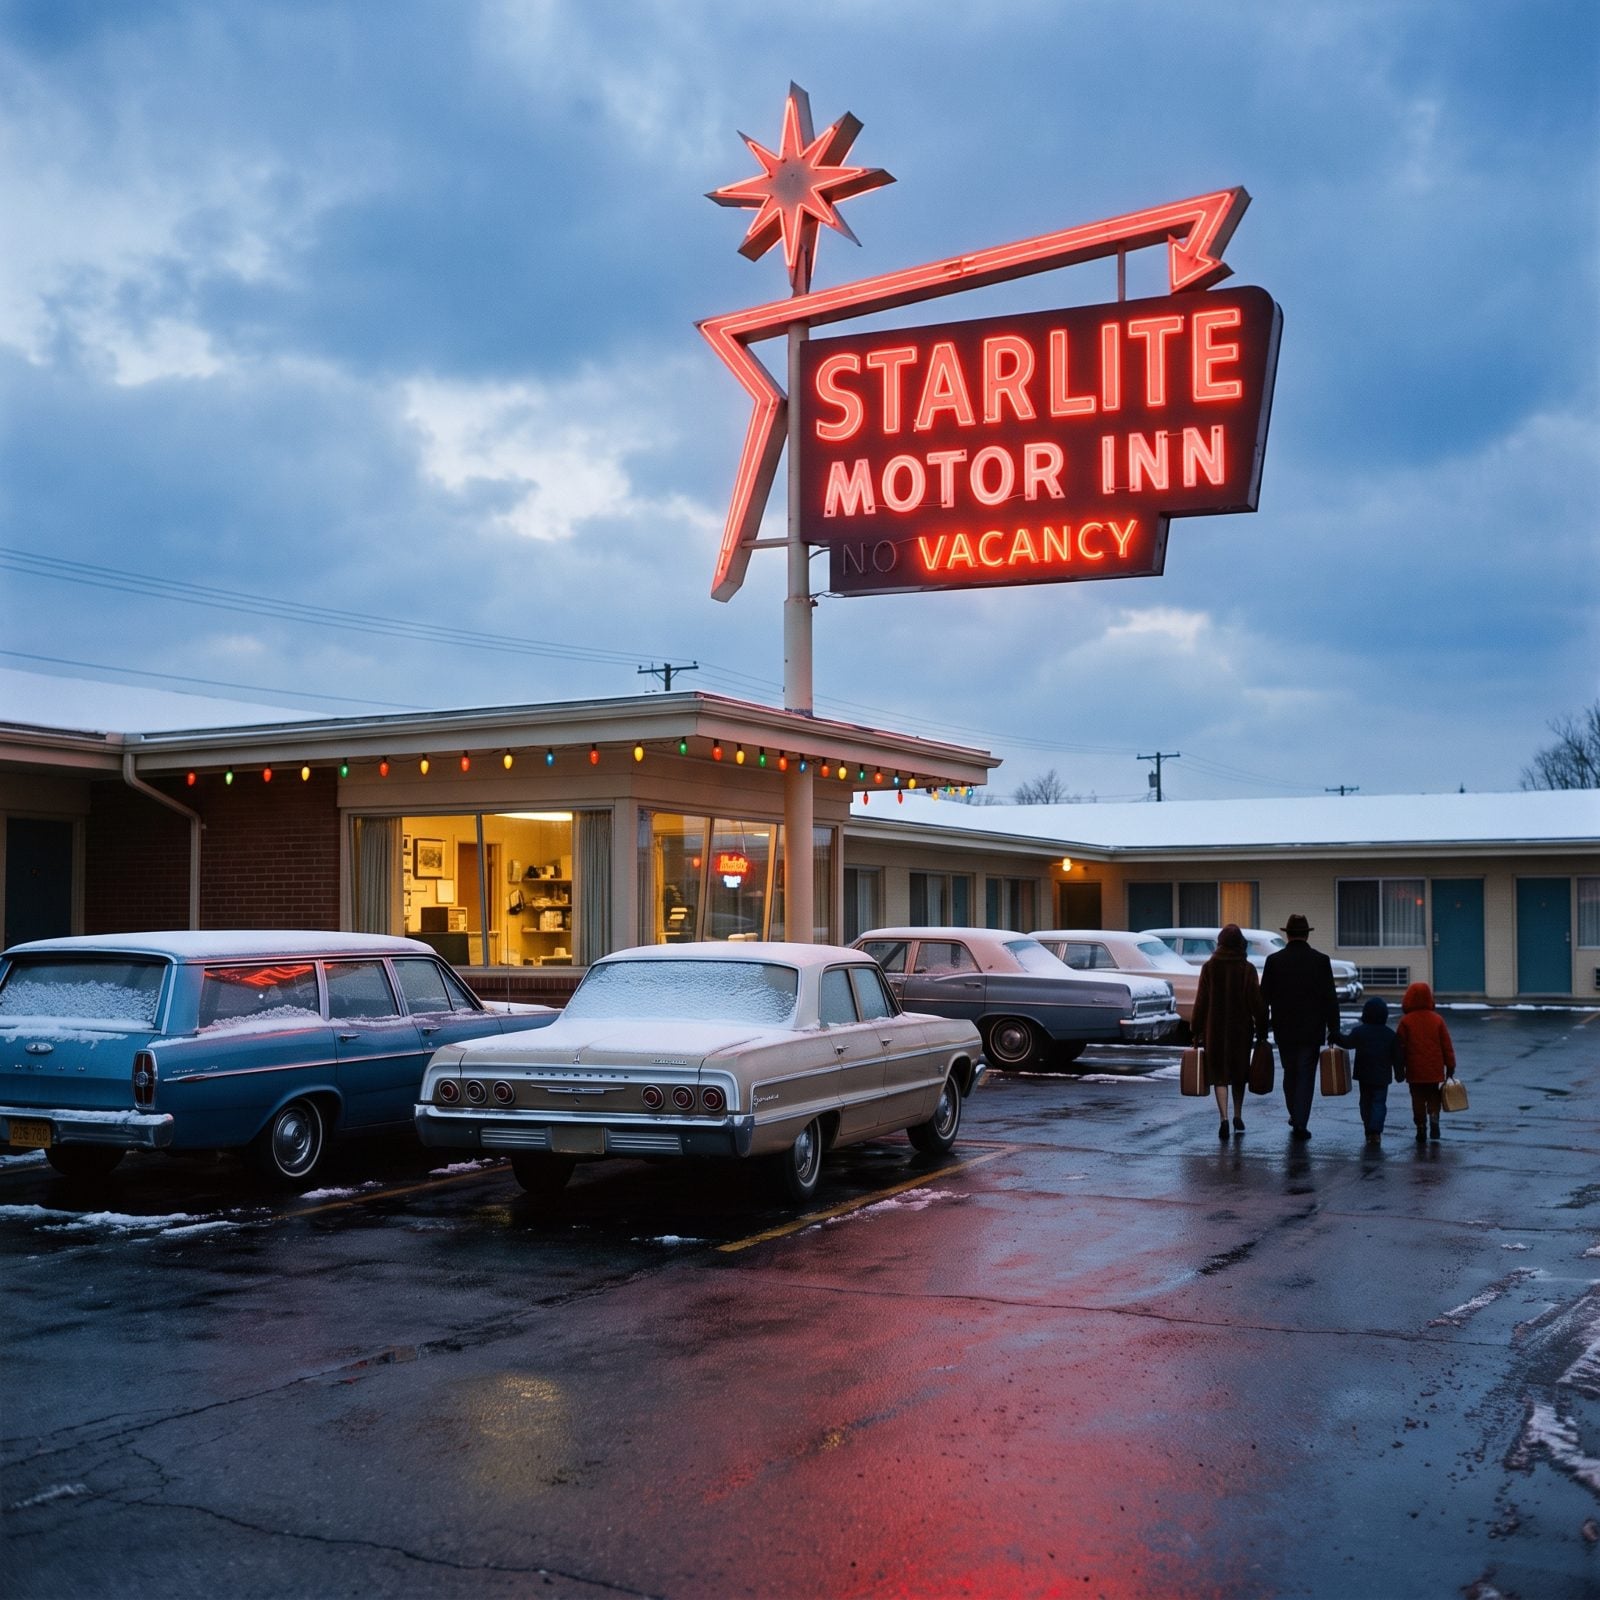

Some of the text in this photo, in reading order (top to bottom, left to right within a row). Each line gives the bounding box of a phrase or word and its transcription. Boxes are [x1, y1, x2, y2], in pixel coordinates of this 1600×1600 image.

[815, 308, 1242, 442] STARLITE
[823, 425, 1225, 518] MOTOR INN
[843, 518, 1139, 576] NO VACANCY
